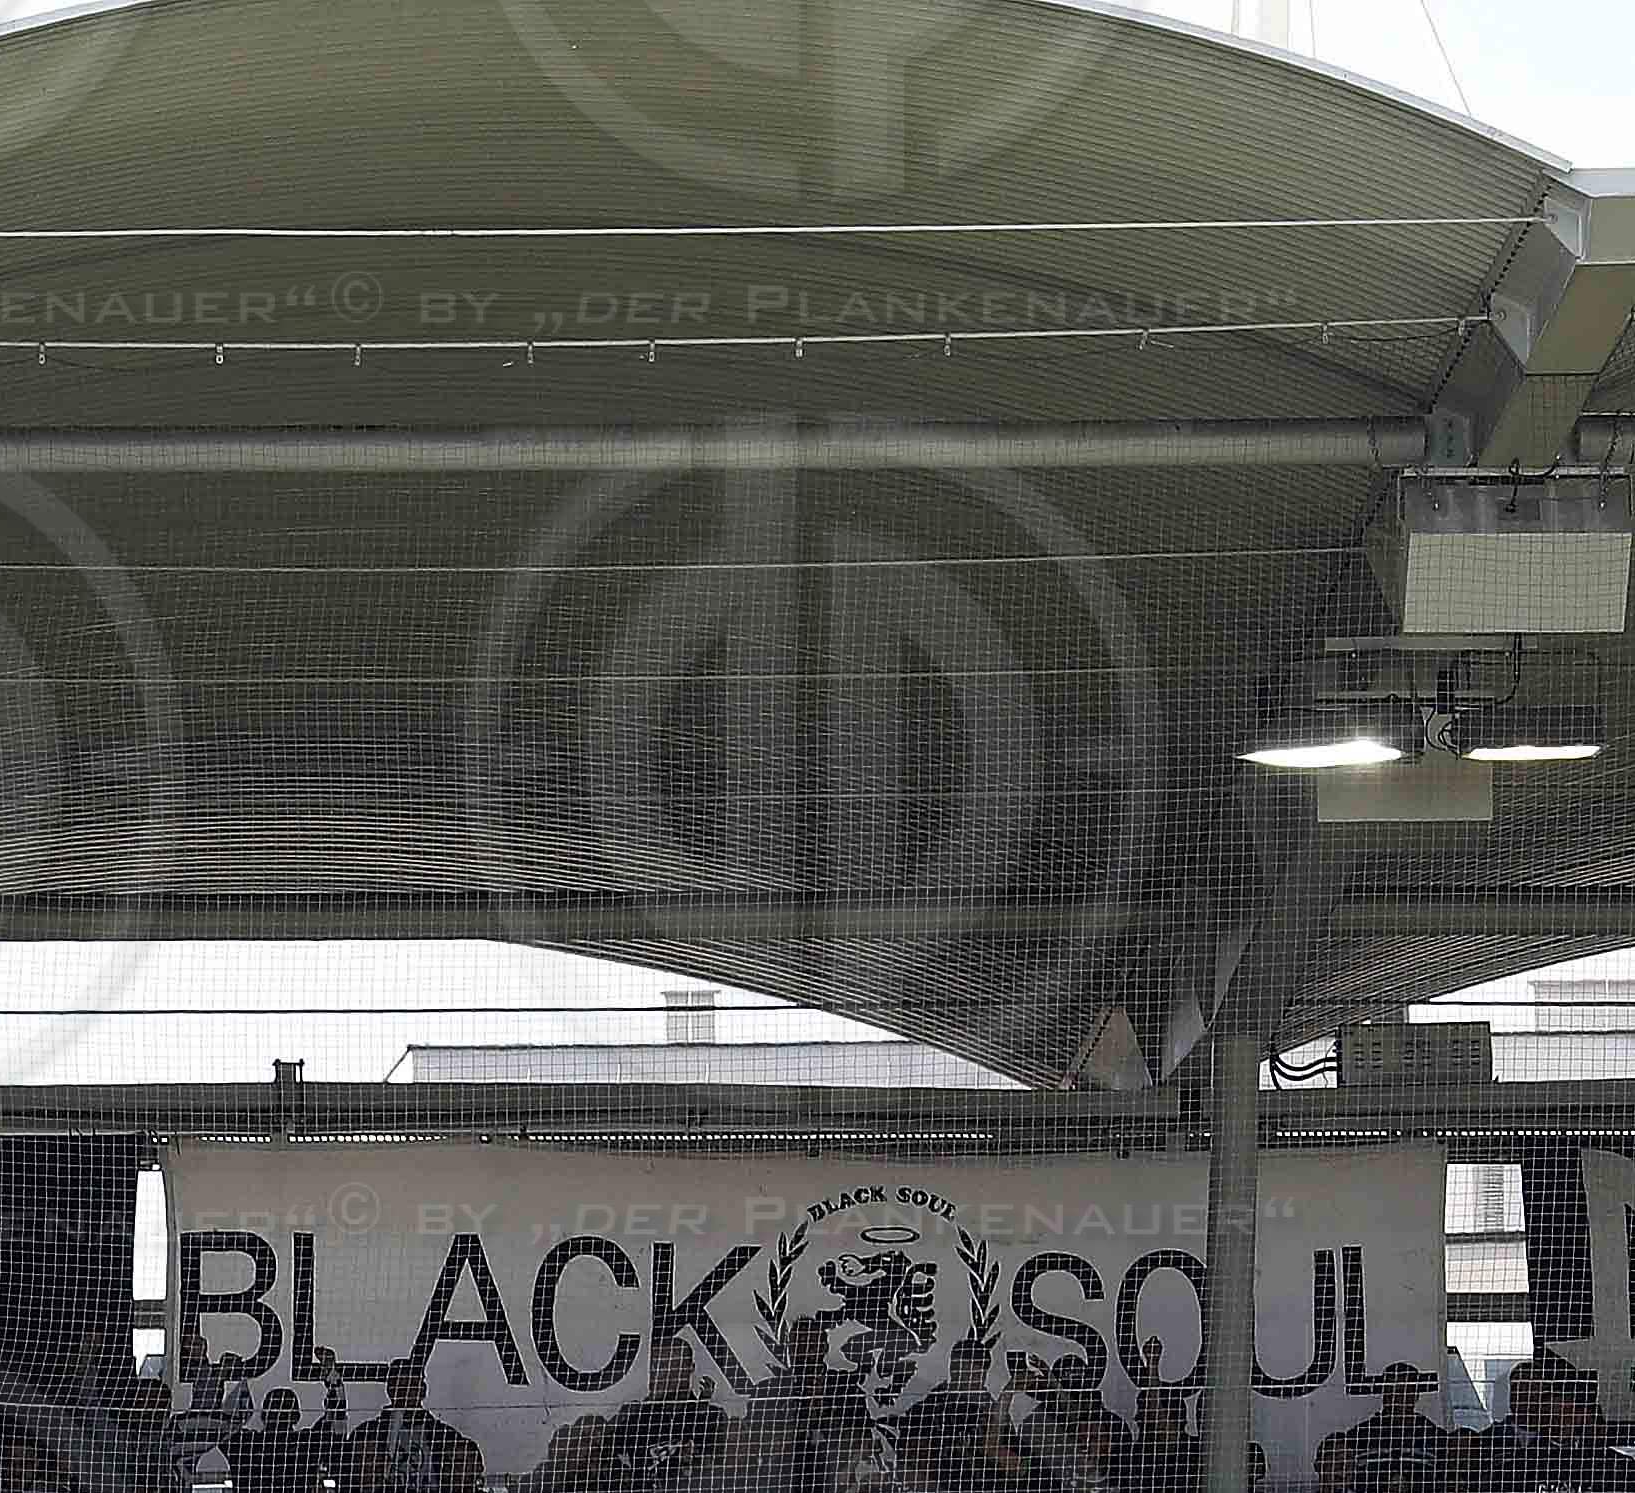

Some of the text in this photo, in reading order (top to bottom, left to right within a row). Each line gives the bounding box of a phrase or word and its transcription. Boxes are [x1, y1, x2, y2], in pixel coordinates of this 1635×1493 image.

[806, 1184, 958, 1223] BLACK SOUL
[178, 1229, 778, 1398] BLACK
[1009, 1243, 1439, 1399] SOUL
